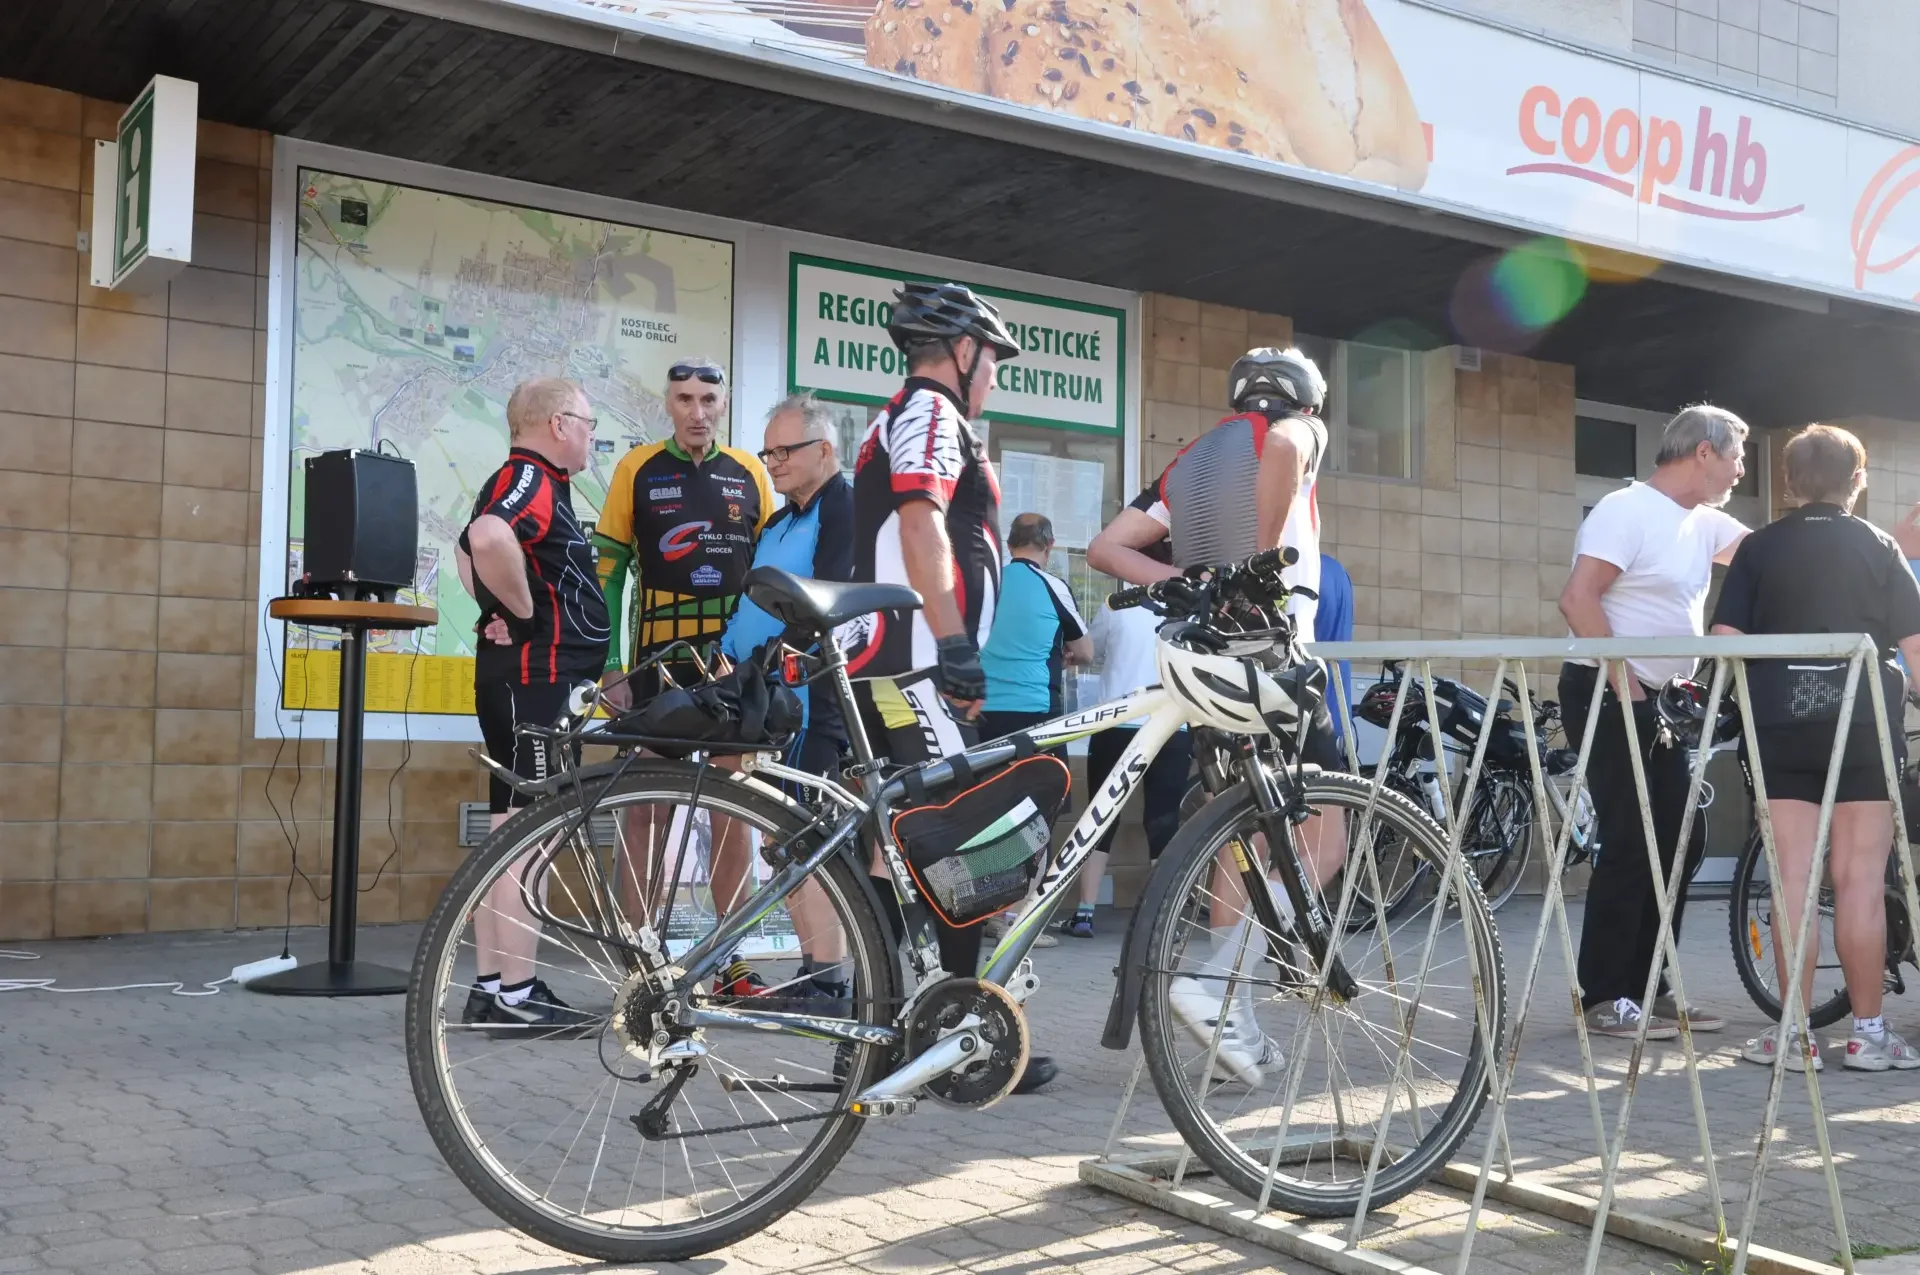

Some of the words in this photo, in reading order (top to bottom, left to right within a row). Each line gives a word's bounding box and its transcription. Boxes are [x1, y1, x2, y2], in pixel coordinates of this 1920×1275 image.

[1518, 85, 1683, 204] coop
[621, 317, 671, 332] KOSTELEC
[621, 328, 643, 338] NAD
[645, 331, 677, 343] ORLICÍ
[818, 291, 893, 329] REGIO
[1005, 322, 1101, 361] RISTICKÉ
[813, 337, 830, 365] A
[837, 340, 909, 376] INFOR
[996, 364, 1102, 404] CENTRUM
[501, 464, 535, 509] MERIDA
[1064, 705, 1128, 728] CLIFF
